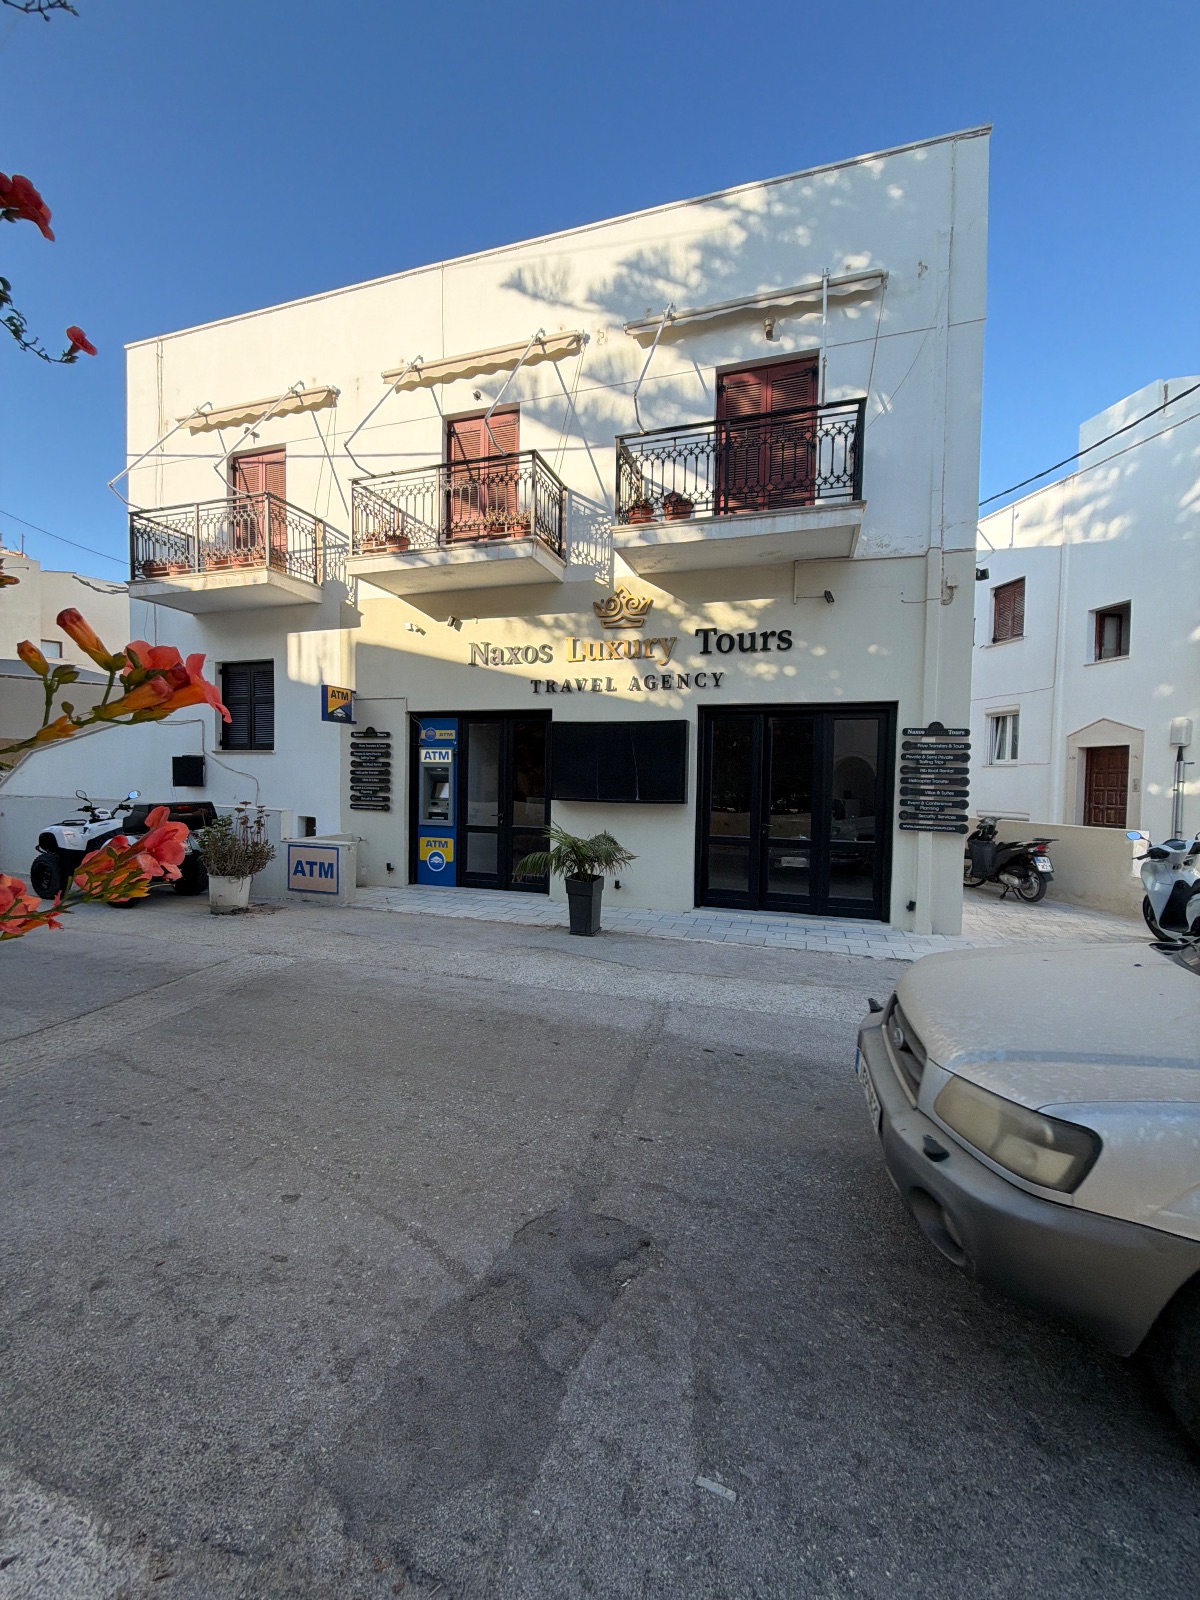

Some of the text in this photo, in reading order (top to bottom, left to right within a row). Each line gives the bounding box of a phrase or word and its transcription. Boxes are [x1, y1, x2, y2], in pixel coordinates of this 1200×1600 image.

[468, 627, 794, 667] Naxos Luxury Tours
[530, 671, 725, 694] TRAVEL AGENCY
[330, 689, 349, 701] ATM
[423, 750, 450, 761] ATM
[425, 839, 449, 849] ATM
[292, 859, 335, 879] ATM
